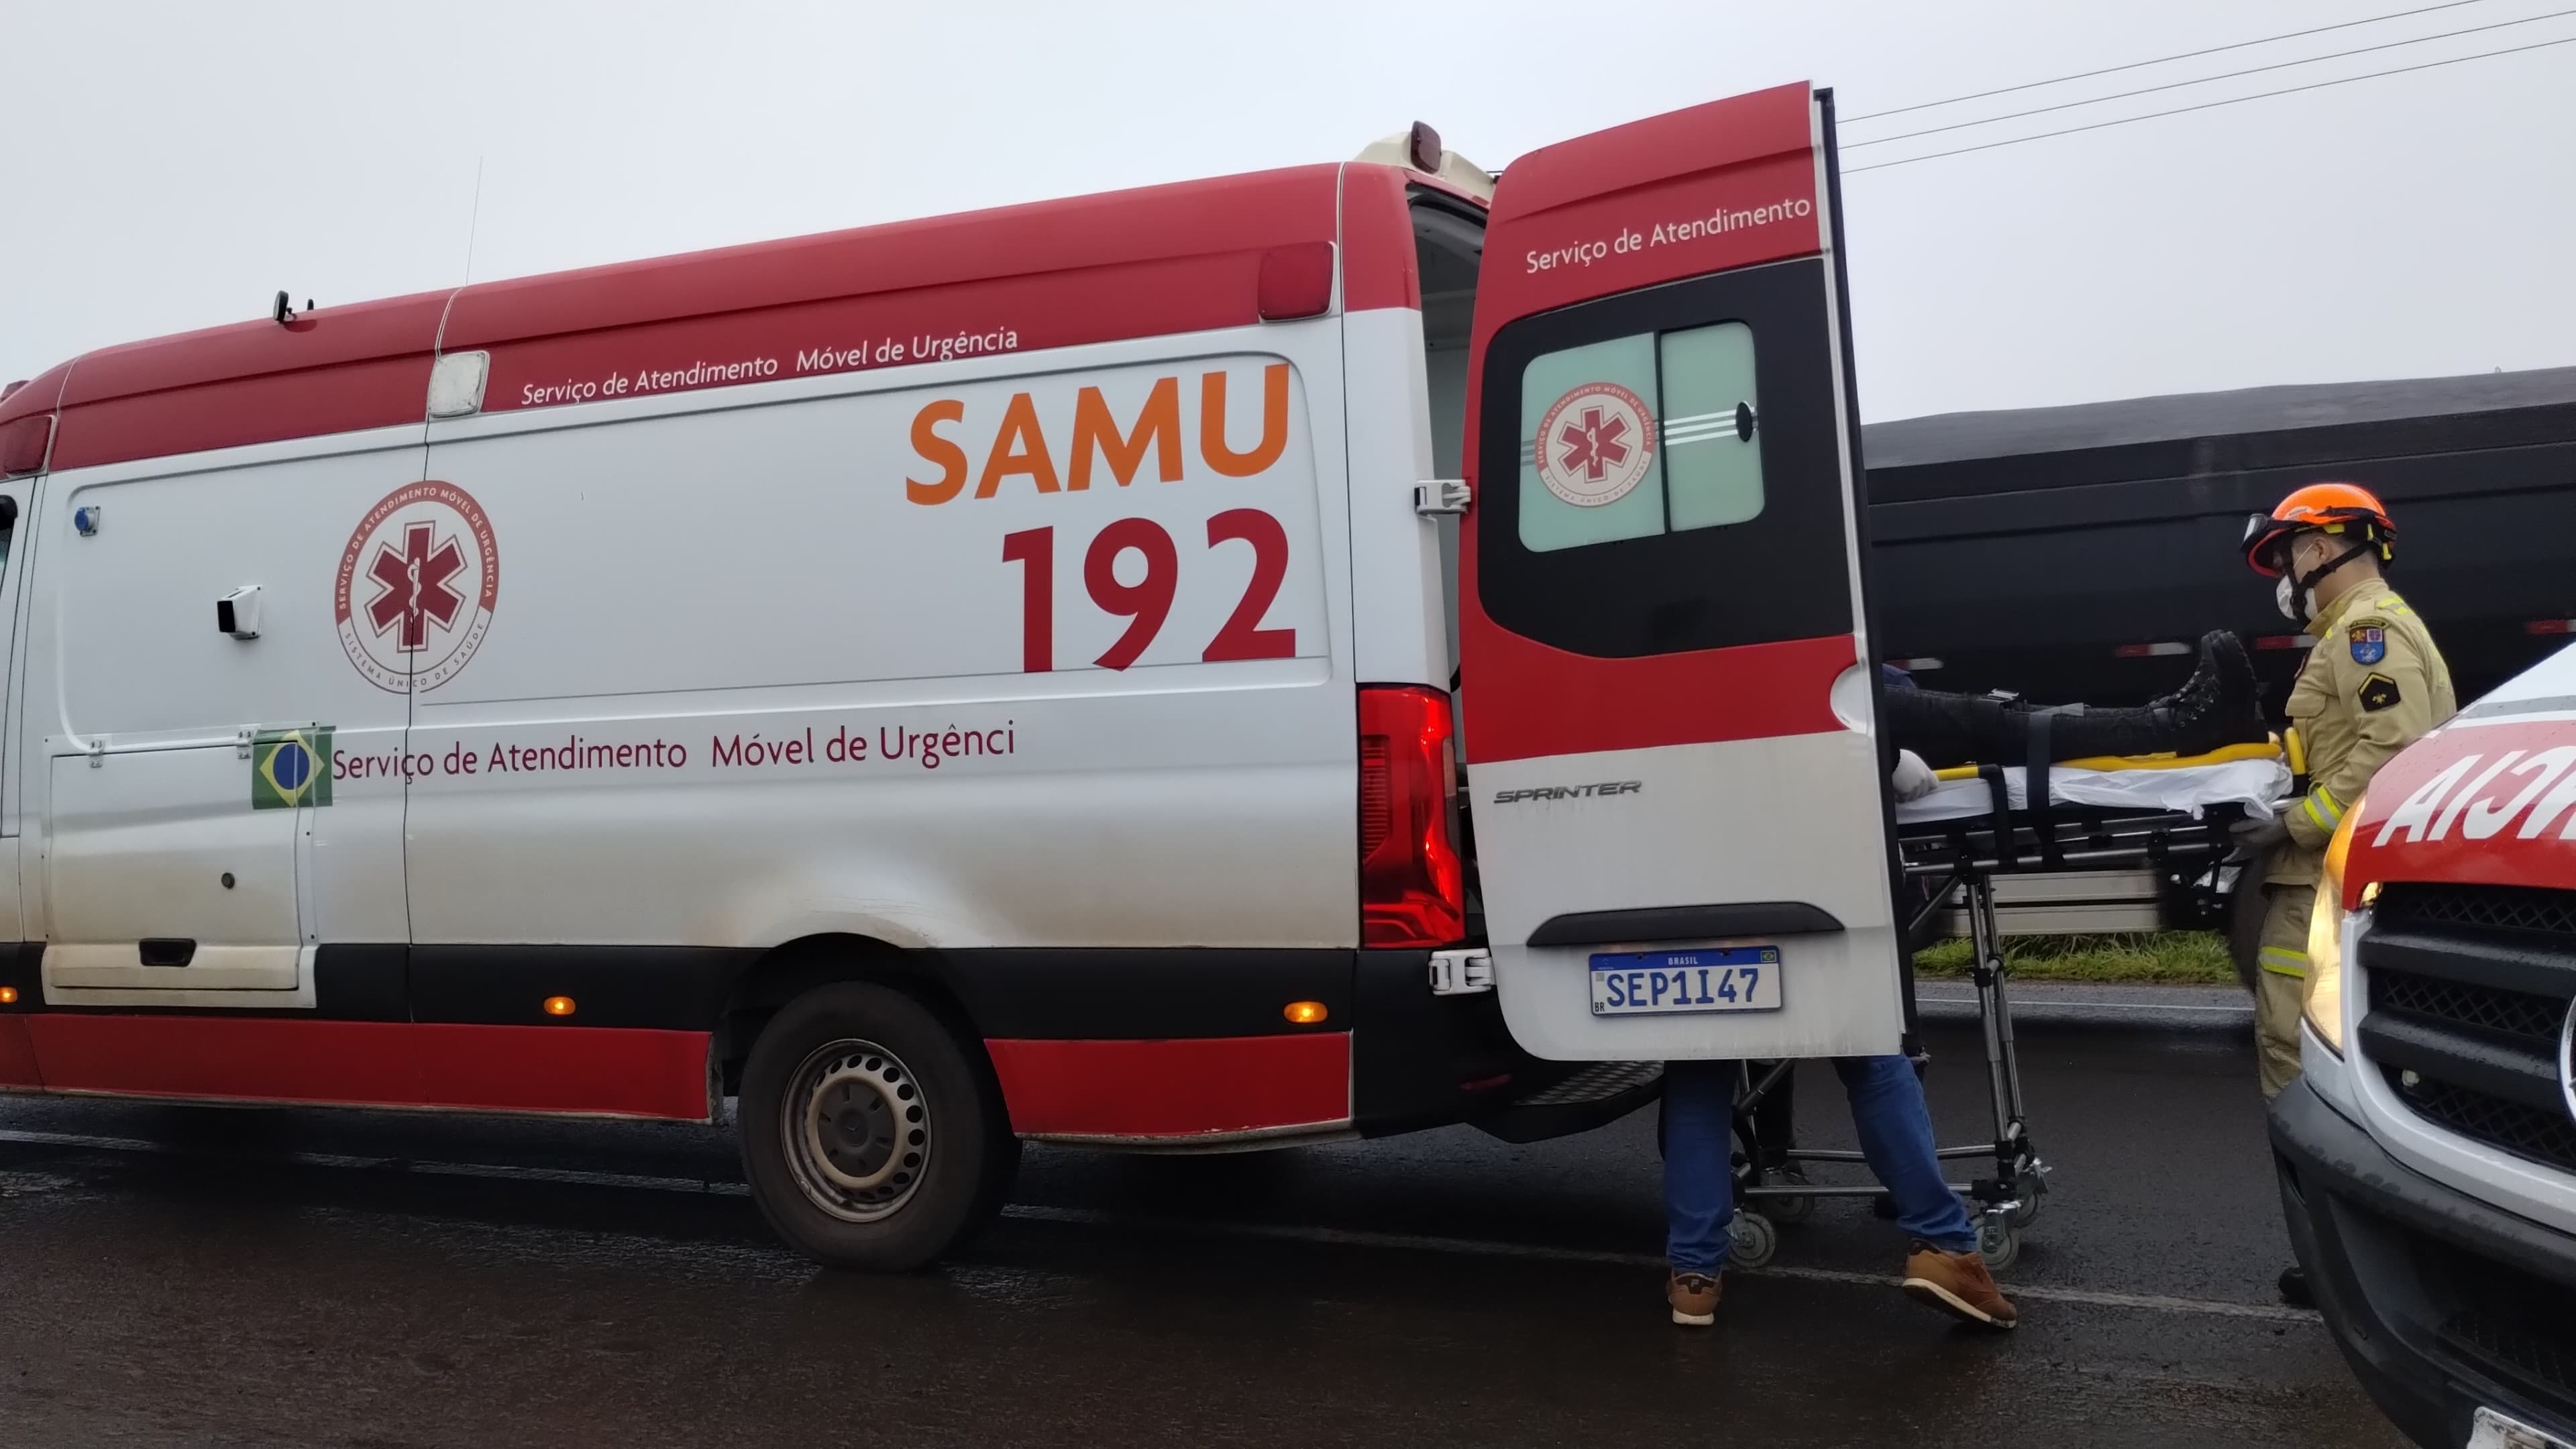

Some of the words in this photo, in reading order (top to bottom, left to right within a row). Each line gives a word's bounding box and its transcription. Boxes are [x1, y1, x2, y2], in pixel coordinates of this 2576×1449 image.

[1527, 241, 1607, 274] Serviço
[1614, 229, 1642, 254] de
[1650, 199, 1811, 247] Atendimento
[521, 378, 596, 404] Serviço
[603, 372, 627, 396] de
[635, 357, 777, 392] Atendimento
[796, 340, 867, 372] Móvel
[875, 337, 904, 363] de
[912, 326, 1017, 362] Urgência
[906, 363, 1289, 505] SAMU
[339, 554, 354, 609] SERVIÇO
[352, 533, 364, 550] DE
[364, 487, 437, 531] ATENDIMENTO
[439, 488, 471, 515] MÓVEL
[470, 513, 483, 529] DE
[480, 530, 496, 598] URGÊNCIA
[1002, 508, 1295, 673] 192
[345, 633, 381, 680] SISTEMA
[388, 677, 427, 688] ÚNICO
[435, 667, 448, 680] DE
[453, 623, 483, 666] SAÚDE
[333, 747, 434, 784] Serviço
[443, 741, 478, 775] de
[488, 735, 687, 773] Atendimento
[712, 727, 814, 767] Móvel
[826, 725, 867, 762] de
[880, 720, 1014, 769] Urgênci
[1493, 780, 1642, 804] SPRINTER
[1606, 968, 1759, 1007] SEP1I47
[1668, 957, 1698, 965] BRASIL
[1595, 1002, 1605, 1012] BR
